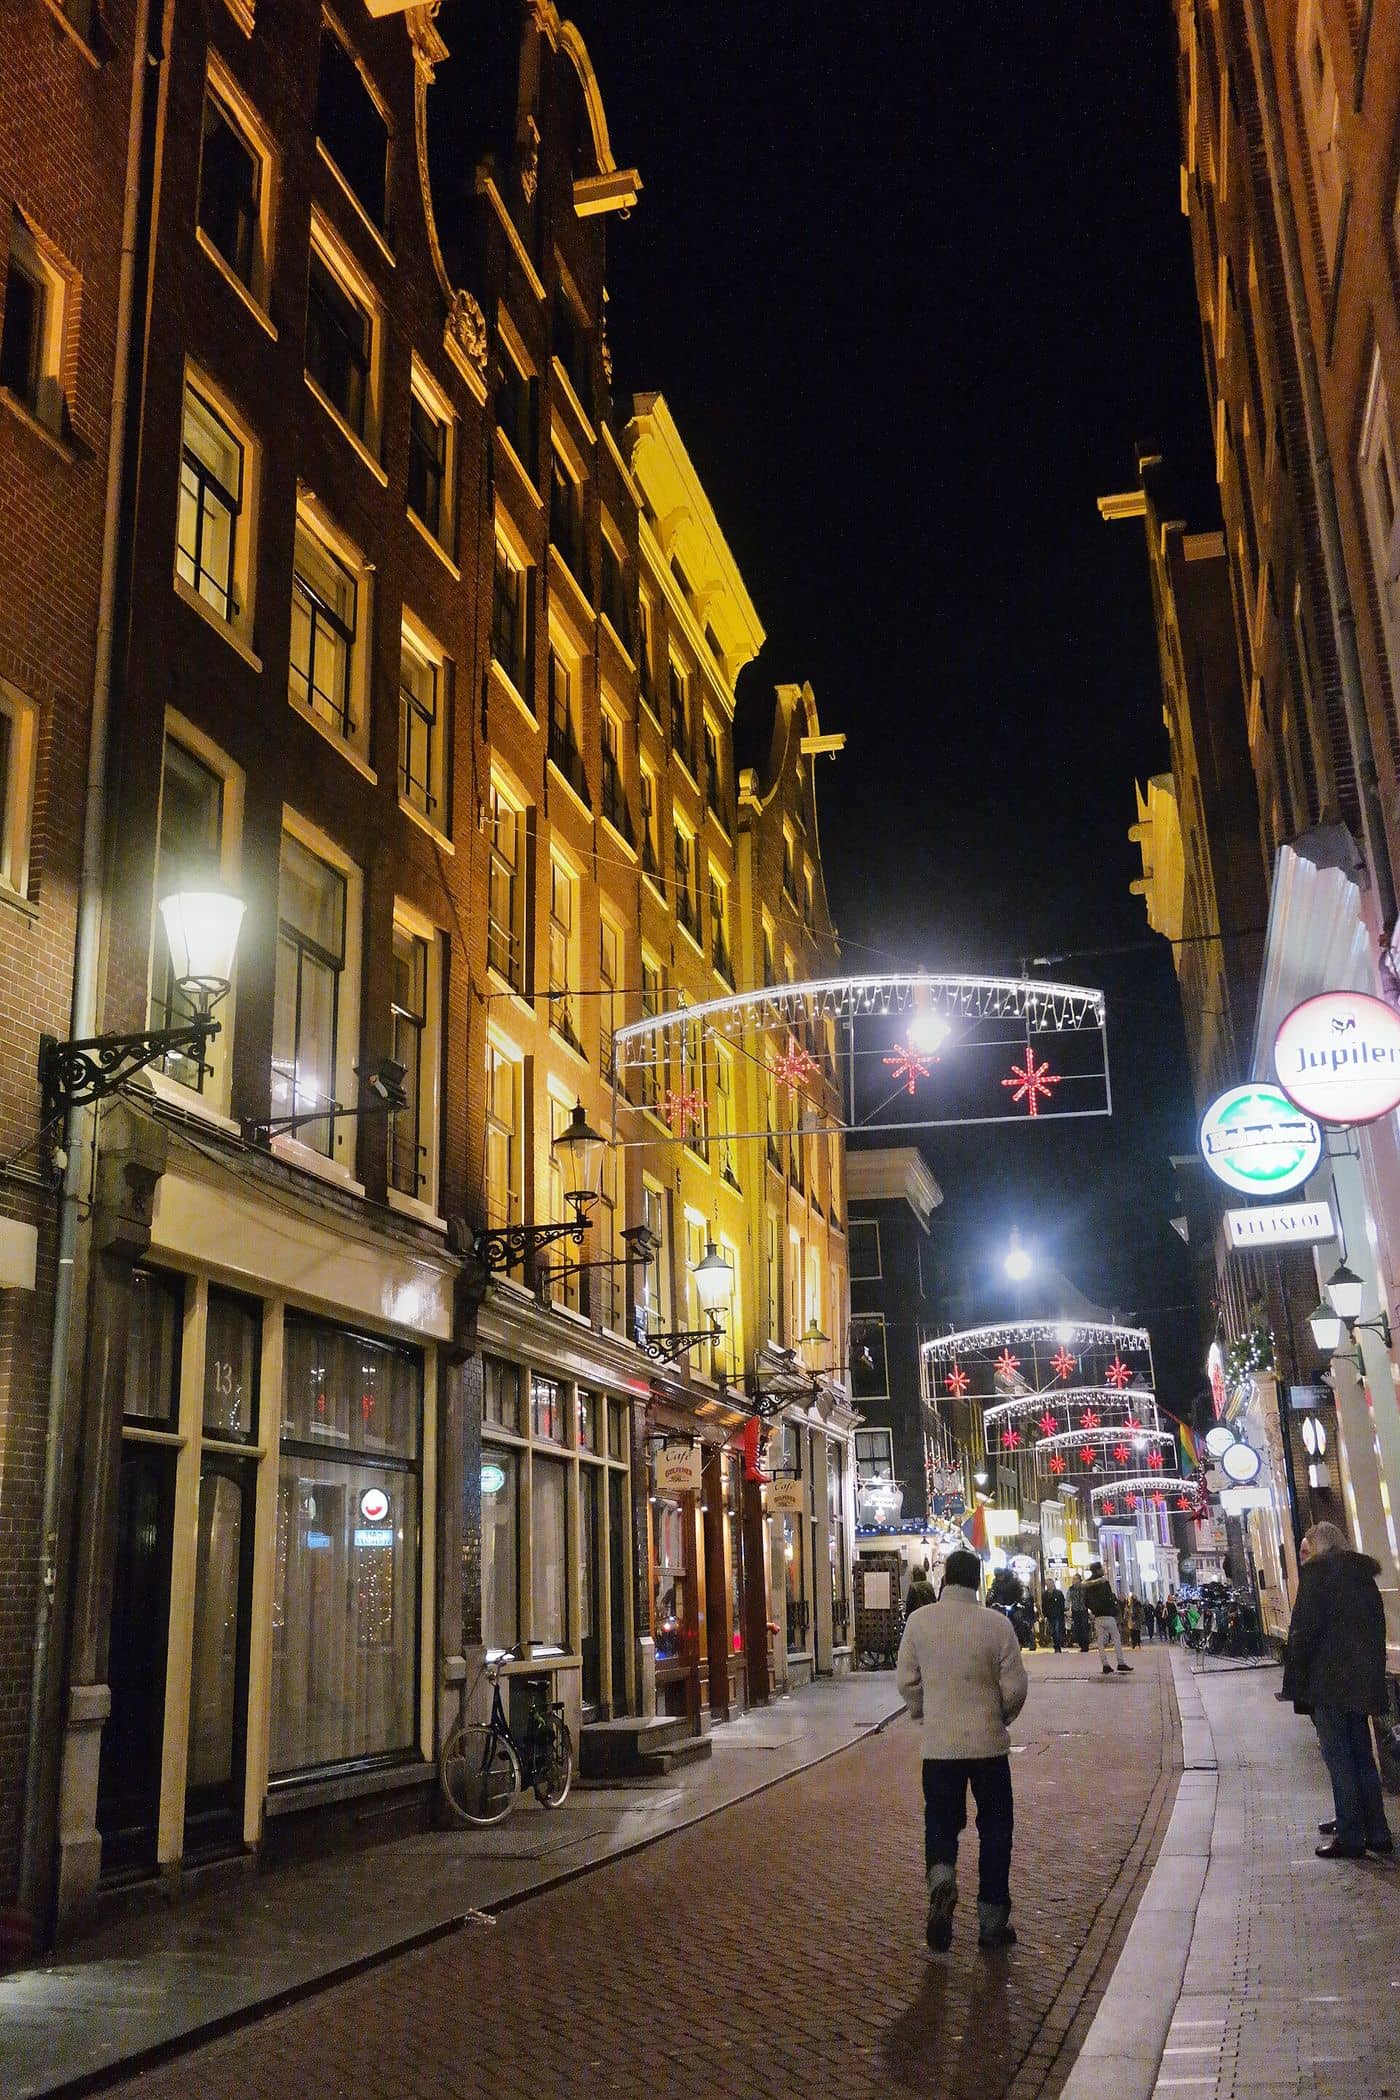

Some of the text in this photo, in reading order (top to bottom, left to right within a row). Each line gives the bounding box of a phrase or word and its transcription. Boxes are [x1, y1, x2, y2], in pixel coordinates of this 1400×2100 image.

[1297, 1042, 1400, 1072] Jupiler
[214, 1360, 232, 1394] 13
[666, 1449, 693, 1464] Café
